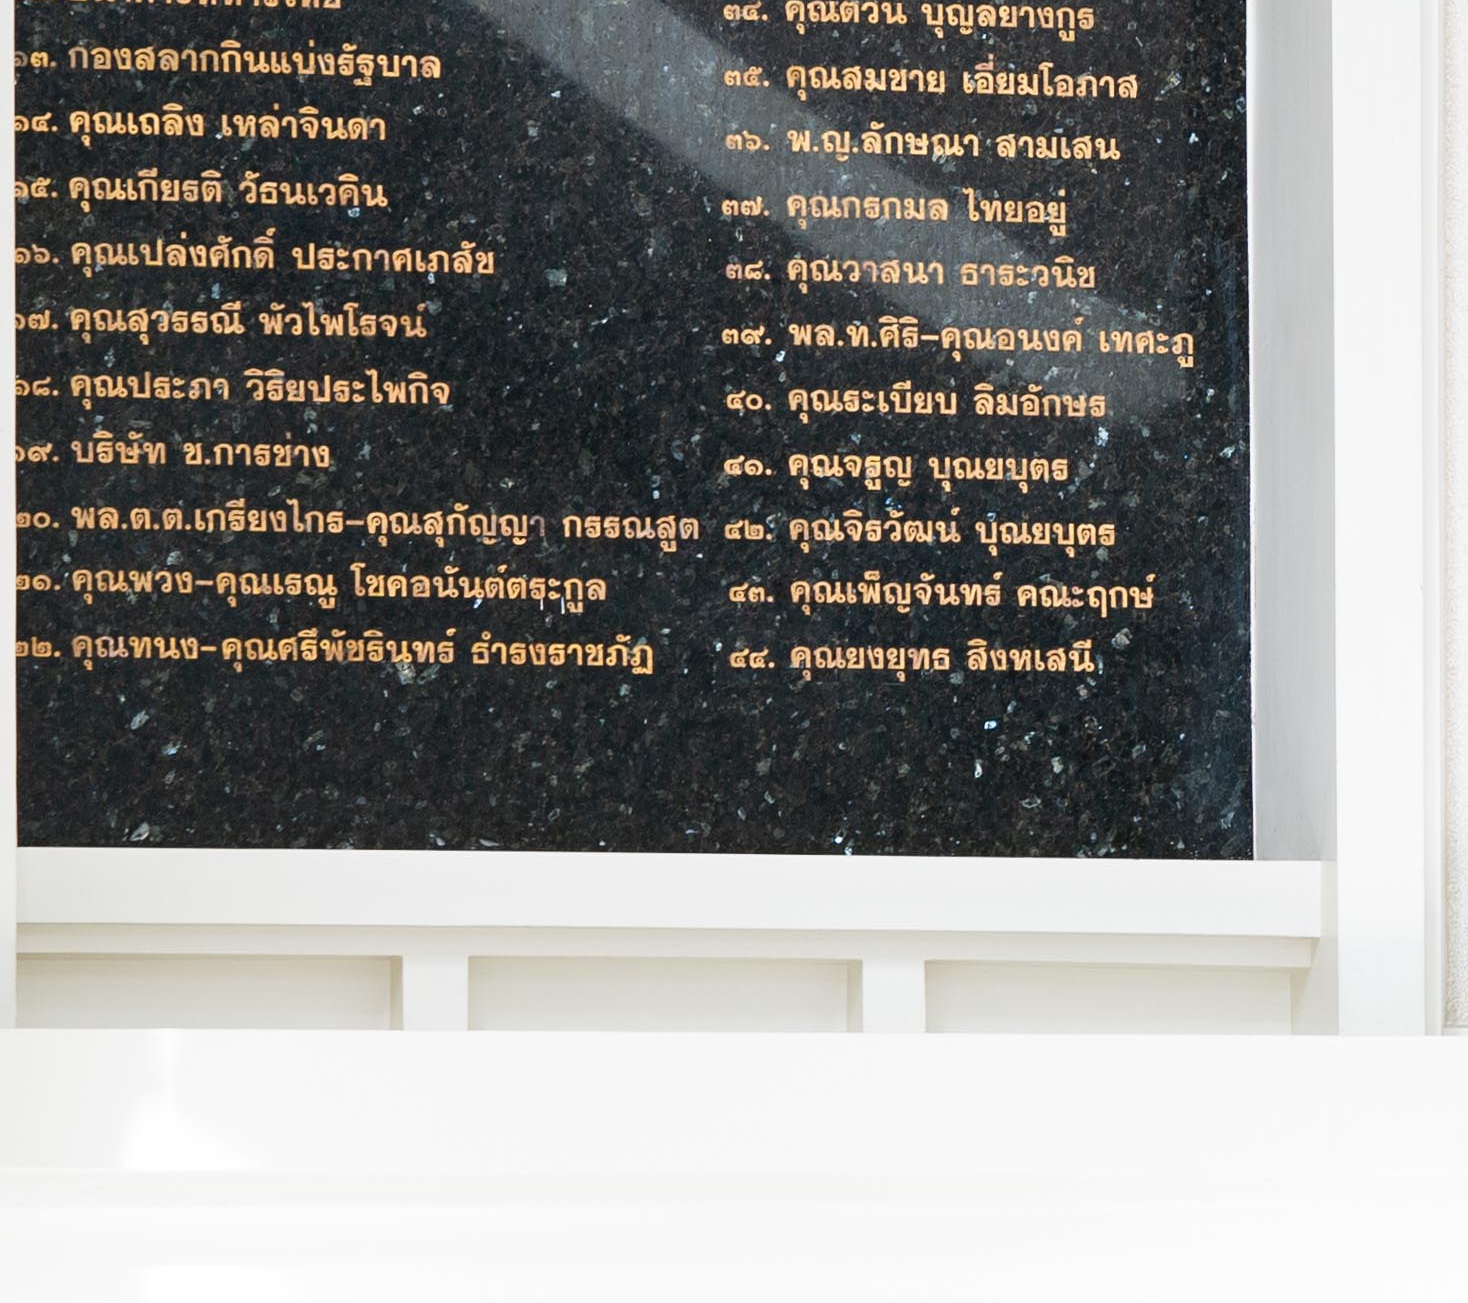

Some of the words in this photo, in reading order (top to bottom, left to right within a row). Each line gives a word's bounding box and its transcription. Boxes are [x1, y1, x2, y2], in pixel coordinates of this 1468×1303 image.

[723, 1, 768, 21] ๓๔.
[921, 3, 1095, 42] บุญลยางกูร
[70, 39, 441, 86] กองสลากกินแบ่งรัฐบาล
[723, 66, 769, 87] ๓๕.
[786, 65, 946, 101] คุณสมชาย
[963, 55, 1138, 99] เอี่ยมโอภาส
[69, 103, 205, 147] คุณเถลิง
[221, 103, 386, 140] เหล่าจินดา
[726, 131, 769, 151] ๓๖.
[787, 122, 979, 162] พ.ญ.ลักษณา
[996, 134, 1121, 160] สามเสน
[69, 167, 222, 213] คุณเกียรติ
[240, 171, 388, 207] วัธนเวคิน
[721, 197, 768, 216] ๓๗.
[787, 195, 949, 229] คุณกรกมล
[962, 188, 1067, 237] ไทยอยู่
[71, 227, 276, 278] คุณเปล่งศักดิ์
[292, 241, 494, 274] ประกาศเภสัช
[726, 261, 771, 280] ๓๘.
[787, 258, 944, 294] คุณวาสนา
[961, 255, 1095, 289] ธาระวนิช
[70, 301, 246, 345] คุณสุวรรณี
[259, 301, 427, 338] พัวไพโรจน์
[722, 325, 772, 345] ๓๙.
[1099, 330, 1194, 367] เทศะภู
[71, 371, 229, 410] คุณประภา
[244, 368, 450, 404] วิริยประไพกิจ
[726, 390, 772, 410] ๔๐.
[788, 381, 957, 424] คุณระเบียบ
[975, 382, 1106, 417] ลิมอักษร
[72, 430, 166, 465] บริษัท
[183, 432, 332, 468] ช.การช่าง
[724, 455, 772, 476] ๔๑.
[788, 454, 912, 490] คุณจรูญ
[928, 457, 1068, 493] บุณยบุตร
[562, 515, 699, 552] กรรณสูต
[724, 519, 772, 540] ๔๒.
[789, 507, 961, 553] คุณจิรวัฒน์
[976, 522, 1116, 558] บุณยบุตร
[72, 569, 338, 609] คุณพวง-คุณเรณู
[350, 562, 606, 613] โชคอนันต์ตระกูล
[729, 583, 773, 602] ๔๓.
[790, 570, 1003, 615] คุณเพ็ญจันทร์
[1017, 573, 1156, 618] คณะฤกษ์
[729, 648, 775, 669] ๔๔.
[790, 646, 951, 682] คุณยงยุทธ
[967, 638, 1095, 672] สิงหเสนี
